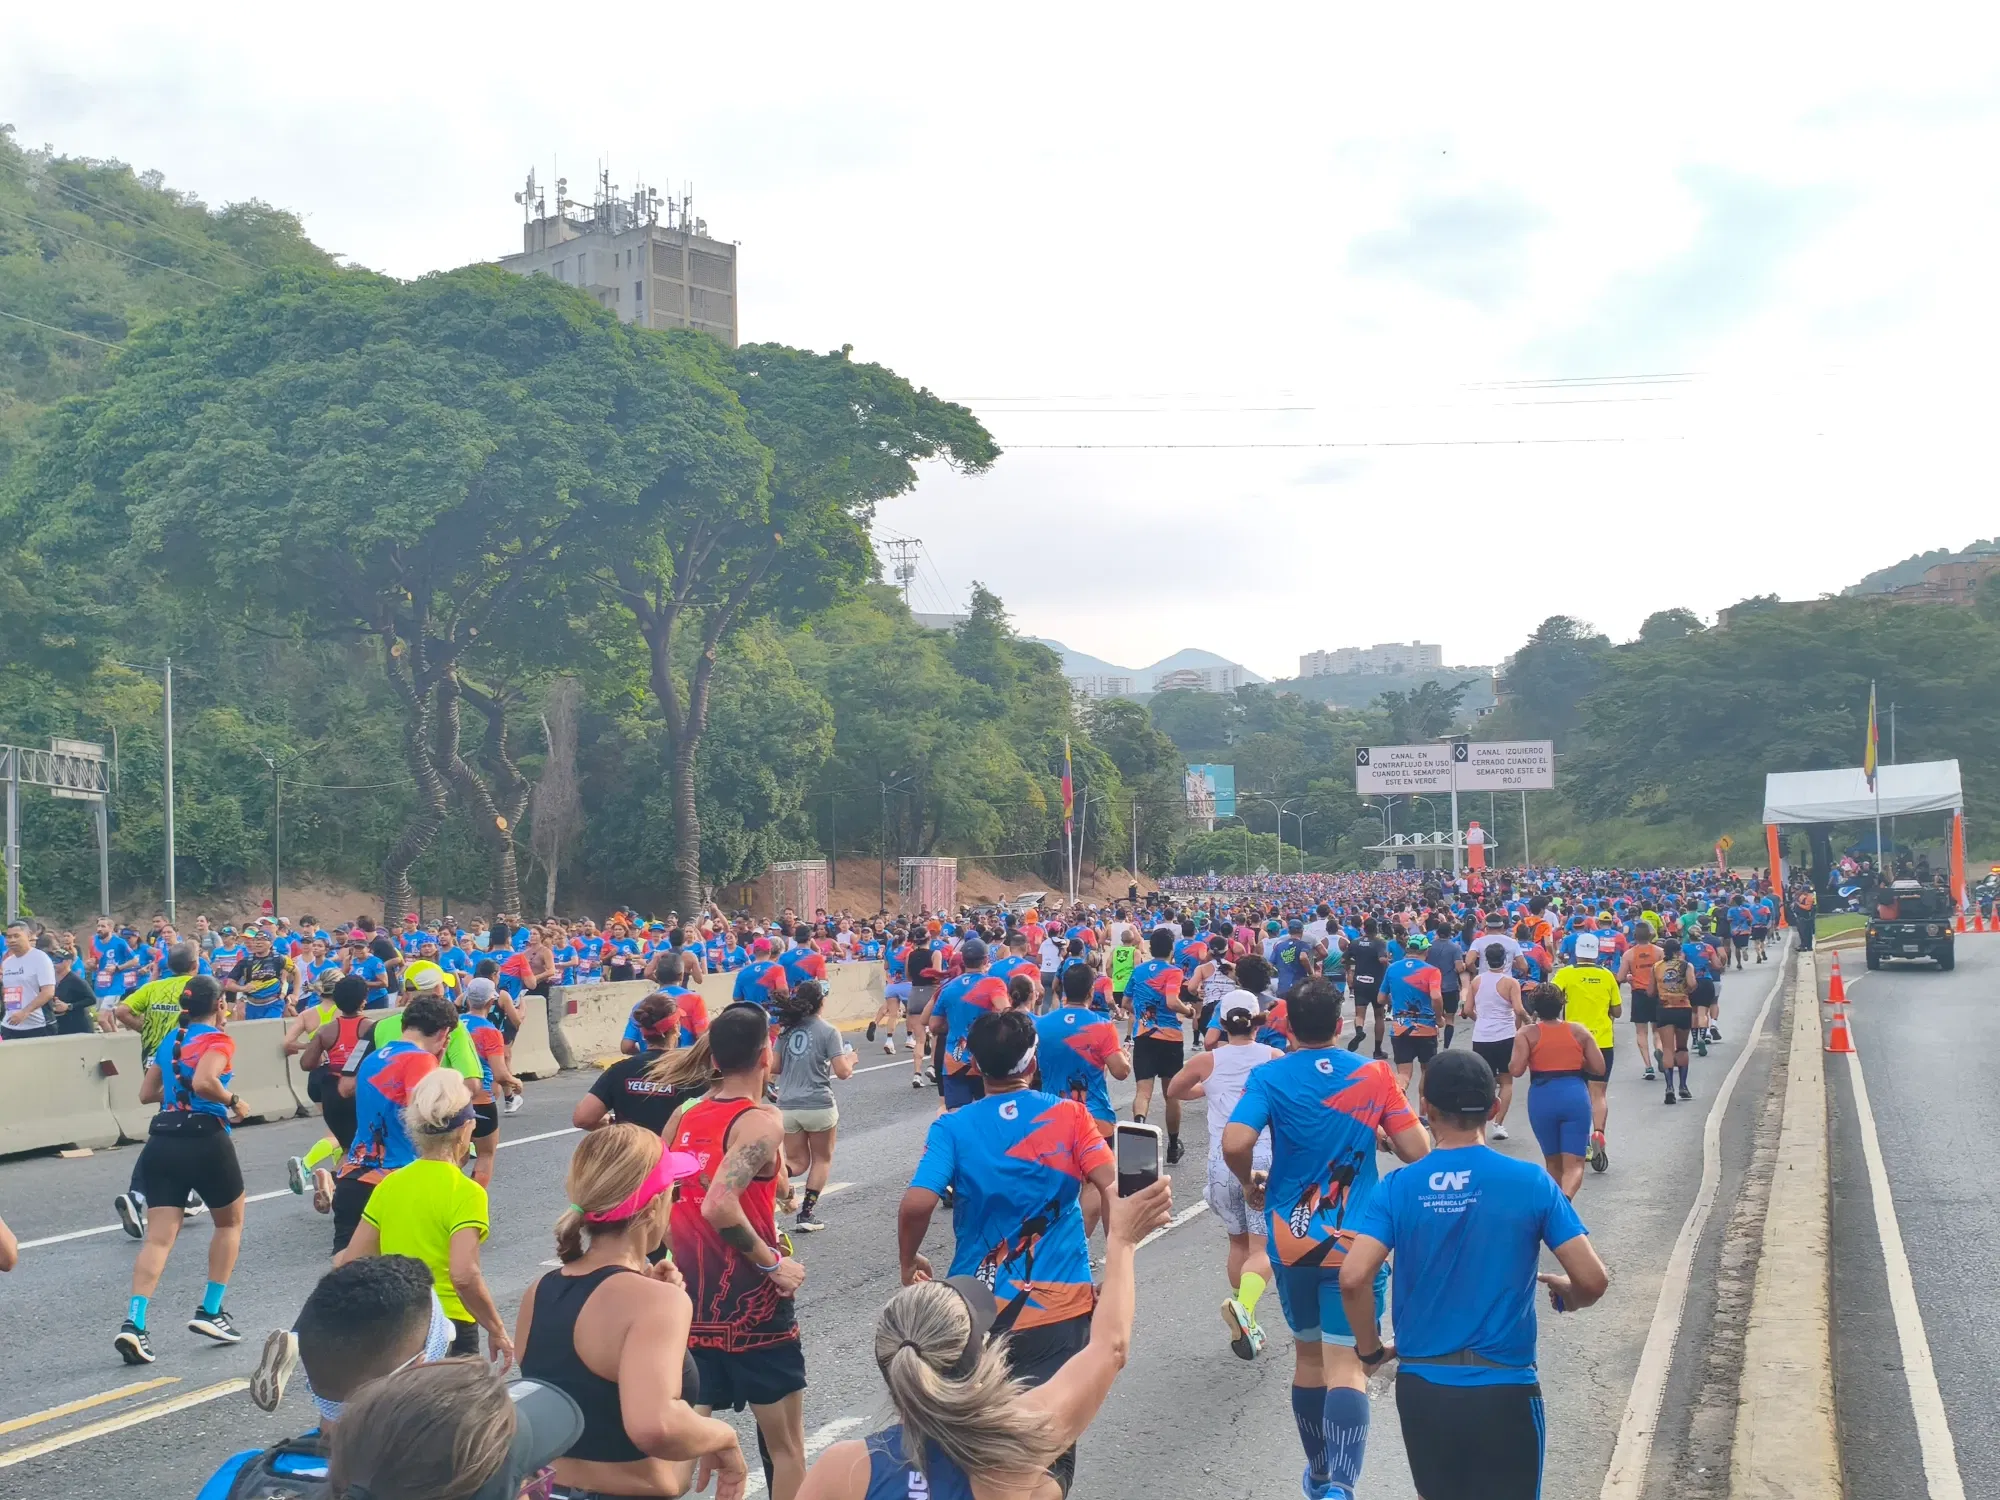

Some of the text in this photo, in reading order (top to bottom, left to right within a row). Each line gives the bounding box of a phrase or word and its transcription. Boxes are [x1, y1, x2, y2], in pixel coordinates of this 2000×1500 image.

[1373, 761, 1422, 769] CONTRAFLUJO
[1064, 1014, 1075, 1024] G
[1315, 1058, 1333, 1074] G
[999, 1100, 1018, 1120] G
[1429, 1170, 1472, 1190] CAF
